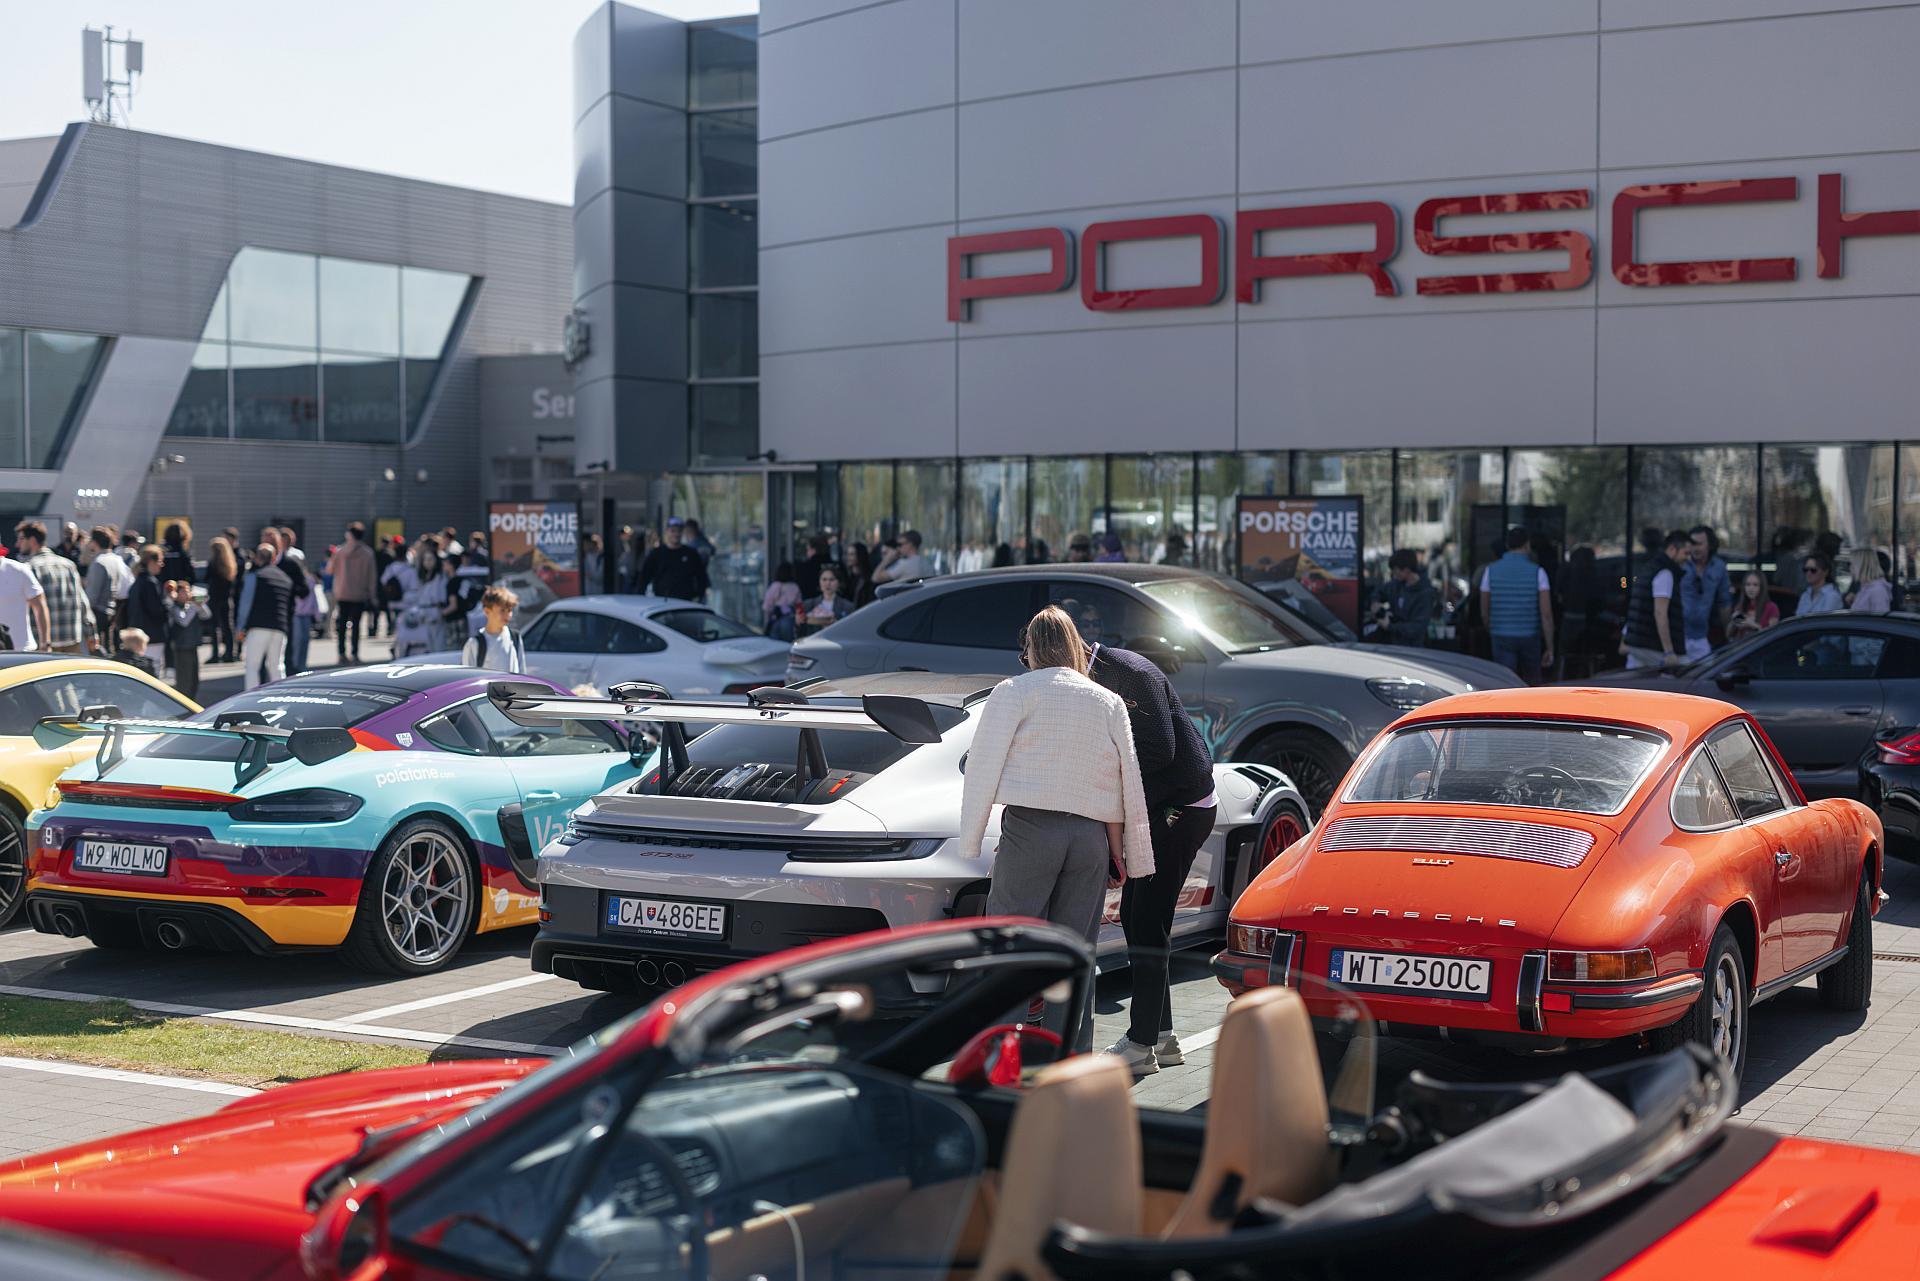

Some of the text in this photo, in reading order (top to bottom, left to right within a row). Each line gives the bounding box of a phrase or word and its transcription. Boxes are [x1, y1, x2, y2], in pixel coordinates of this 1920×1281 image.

[489, 511, 578, 532] PORSCHE
[1240, 510, 1359, 533] PORSCHE
[534, 531, 577, 545] KAWA
[1289, 532, 1356, 549] I KAWA
[45, 827, 53, 845] 9
[85, 844, 165, 869] W9 WOLMO
[620, 901, 721, 932] CA 486EE
[1313, 906, 1517, 927] PORSCHE
[1331, 970, 1341, 979] PL
[1349, 954, 1483, 991] WT 2500C
